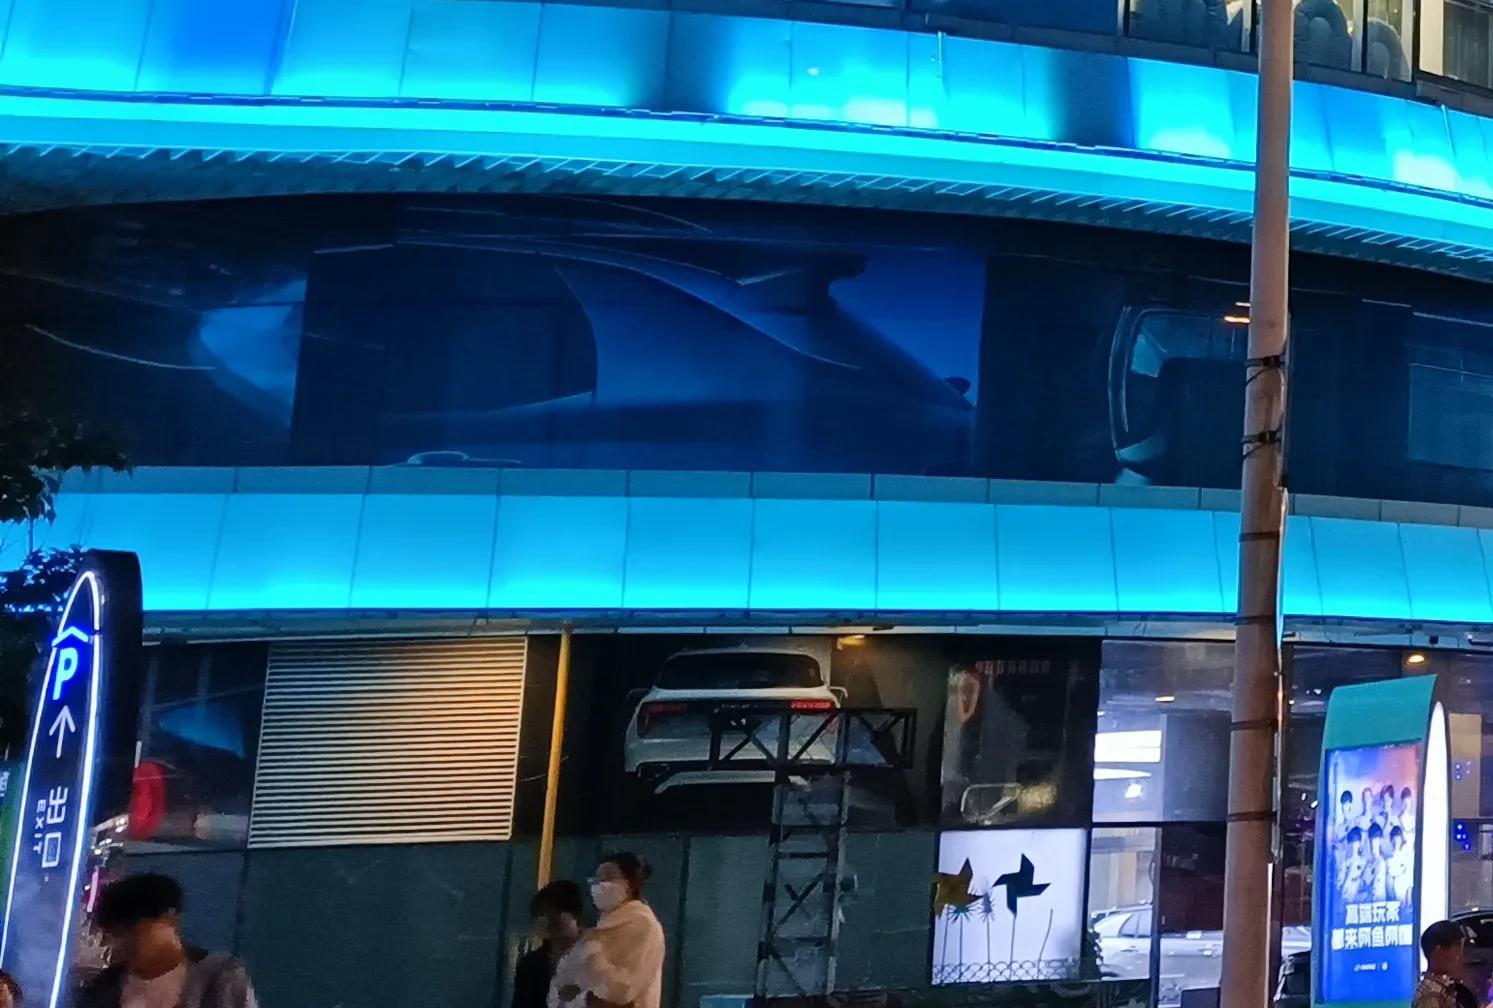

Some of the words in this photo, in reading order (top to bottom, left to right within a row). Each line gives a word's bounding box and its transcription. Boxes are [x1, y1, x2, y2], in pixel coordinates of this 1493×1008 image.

[52, 647, 79, 701] P
[33, 799, 47, 855] EXIT
[42, 785, 69, 868] 出口
